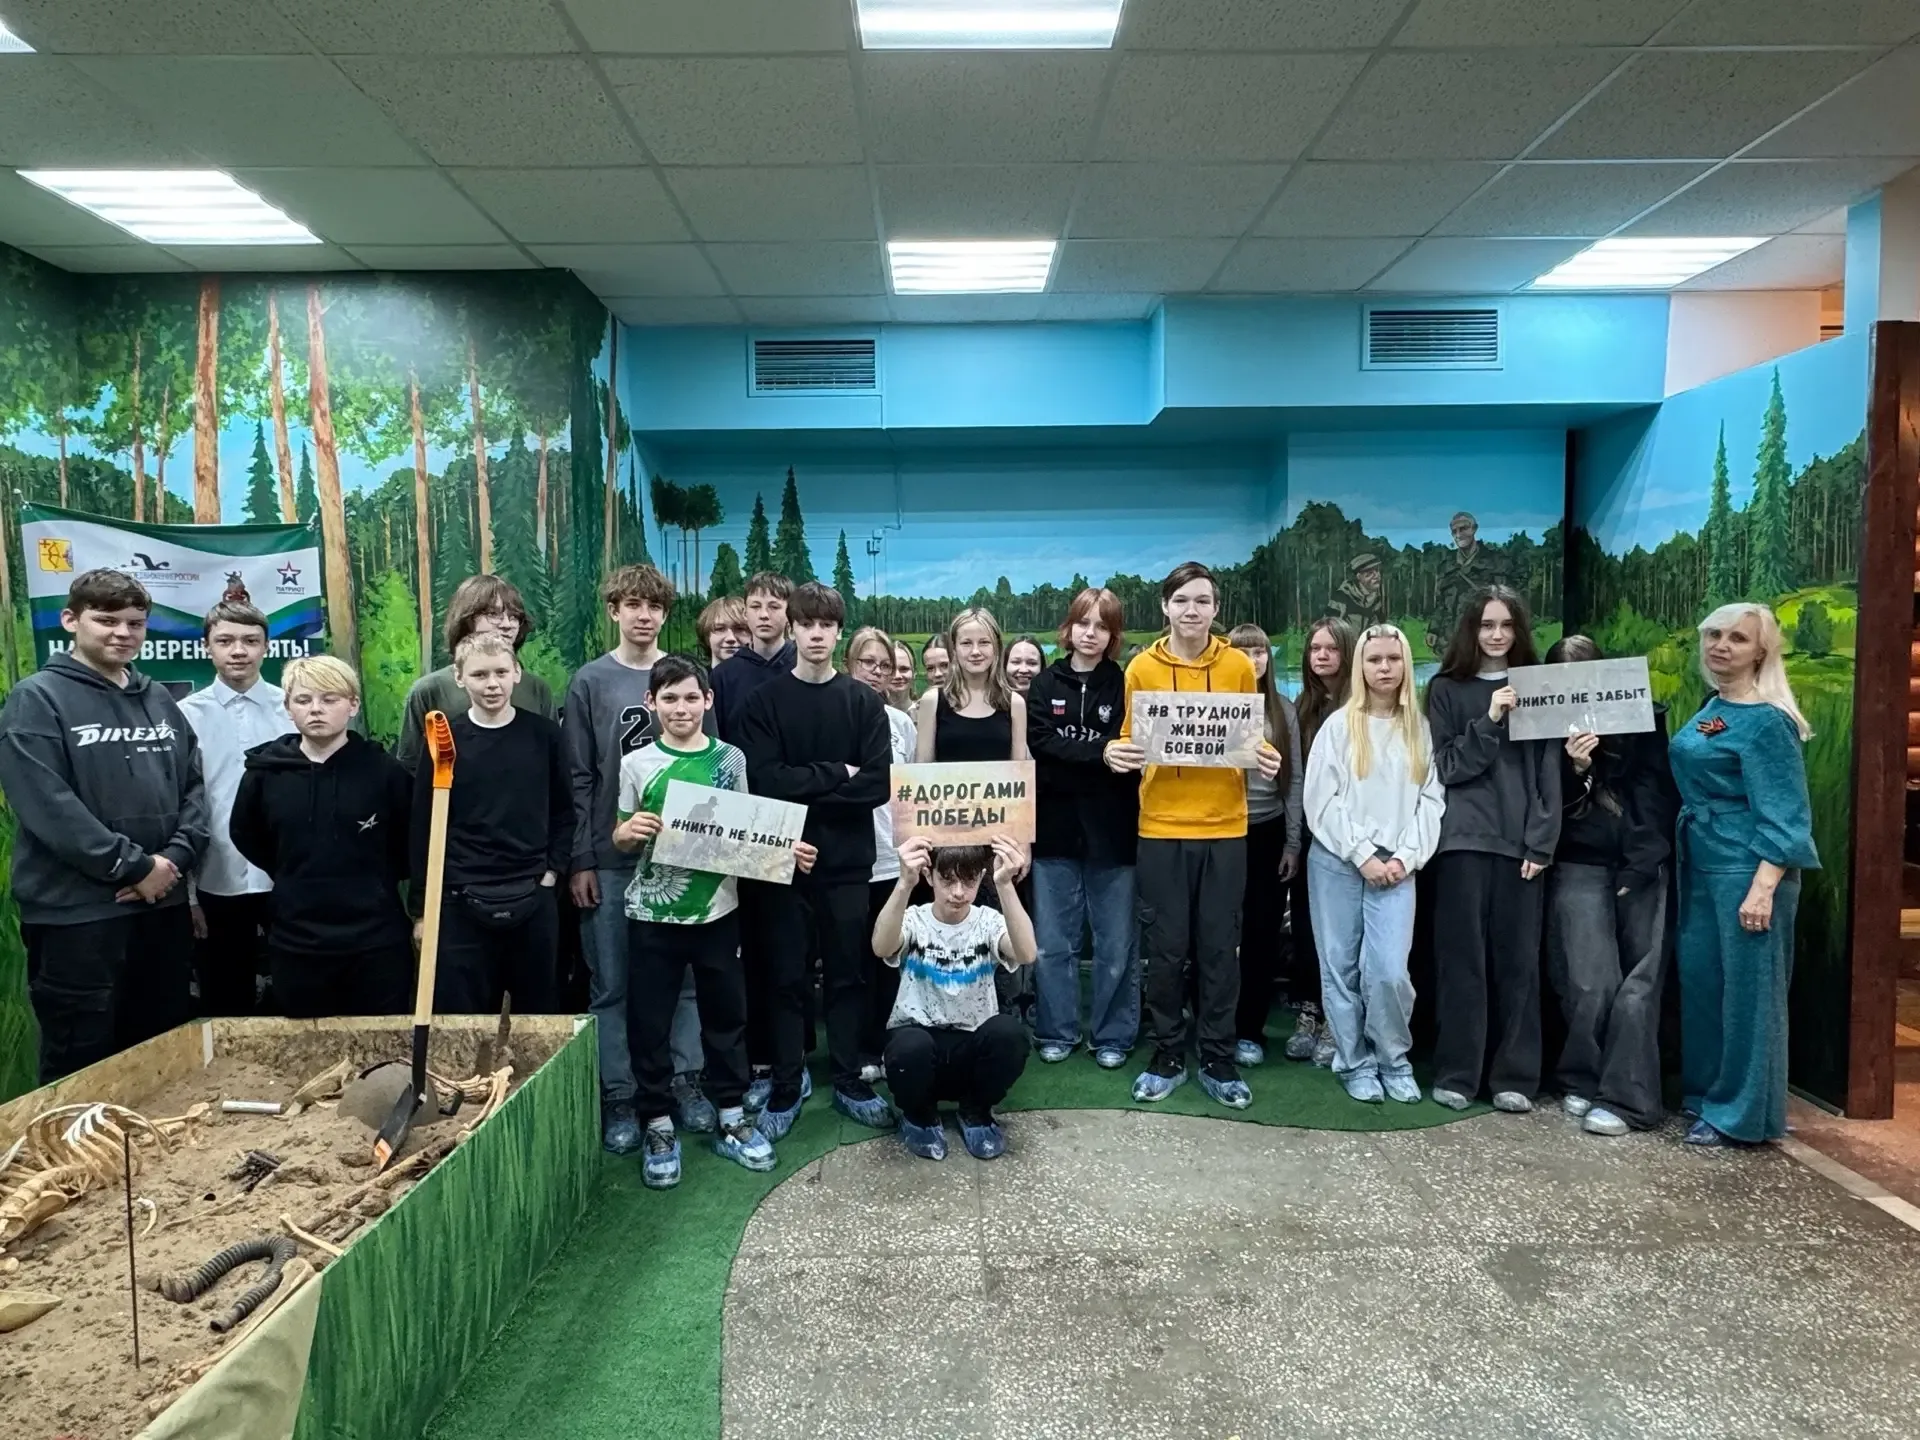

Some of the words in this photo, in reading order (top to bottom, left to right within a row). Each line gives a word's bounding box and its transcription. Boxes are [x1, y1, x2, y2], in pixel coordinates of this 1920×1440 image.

[1515, 694, 1565, 707] #НИКТО
[1571, 692, 1589, 704] НЕ
[1596, 687, 1646, 702] ЗАБЫТ
[1147, 704, 1169, 718] #В
[1176, 703, 1252, 720] ТРУДНОЙ
[1170, 723, 1227, 738] ЖИЗНИ
[1164, 739, 1225, 755] БОЕВОЙ
[897, 780, 1026, 804] #ДОРОГАМИ
[916, 806, 1006, 828] ПОБЕДЫ
[671, 818, 724, 837] #НИКТО
[728, 828, 747, 841] НЕ
[750, 832, 795, 849] ЗАБЫТ
